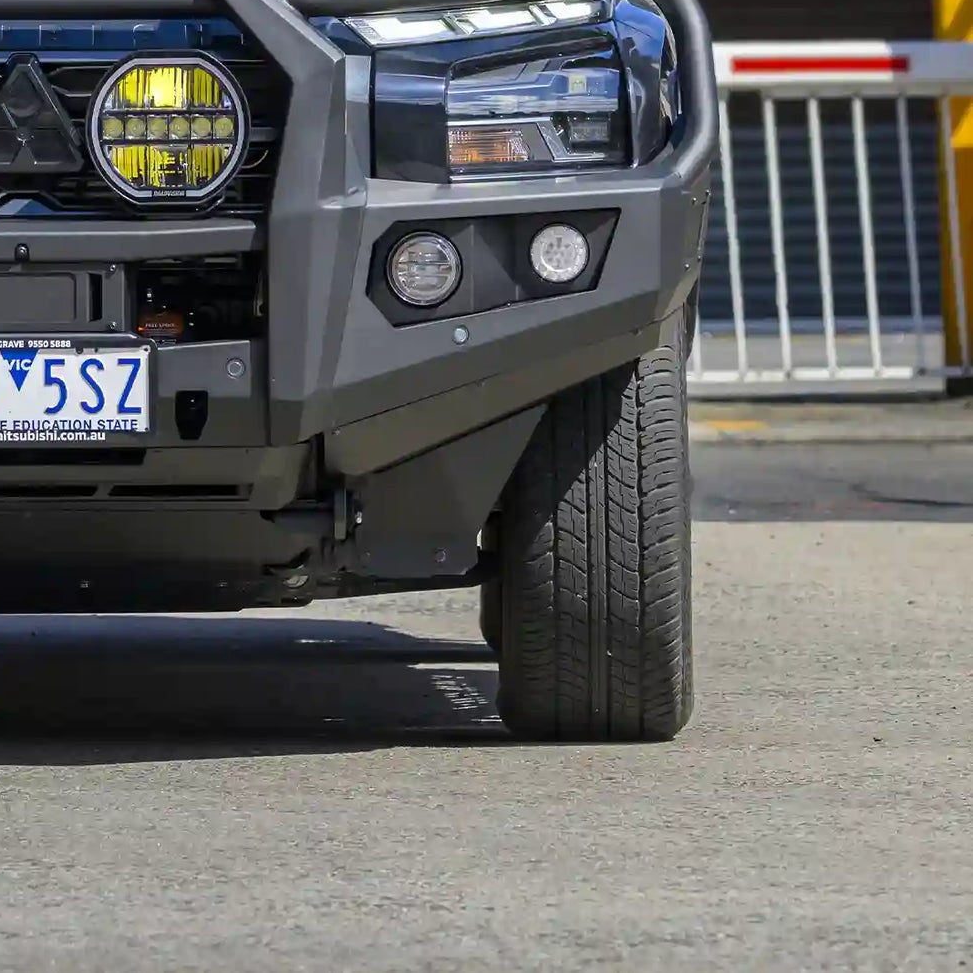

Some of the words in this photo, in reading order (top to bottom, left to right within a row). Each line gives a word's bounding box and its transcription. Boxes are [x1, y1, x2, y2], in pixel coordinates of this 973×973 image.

[27, 339, 48, 348] 9550
[50, 339, 71, 348] 5888
[4, 358, 33, 372] VIC
[43, 358, 143, 415] 5SZ
[12, 419, 93, 432] EDUCATION
[97, 418, 139, 431] STATE
